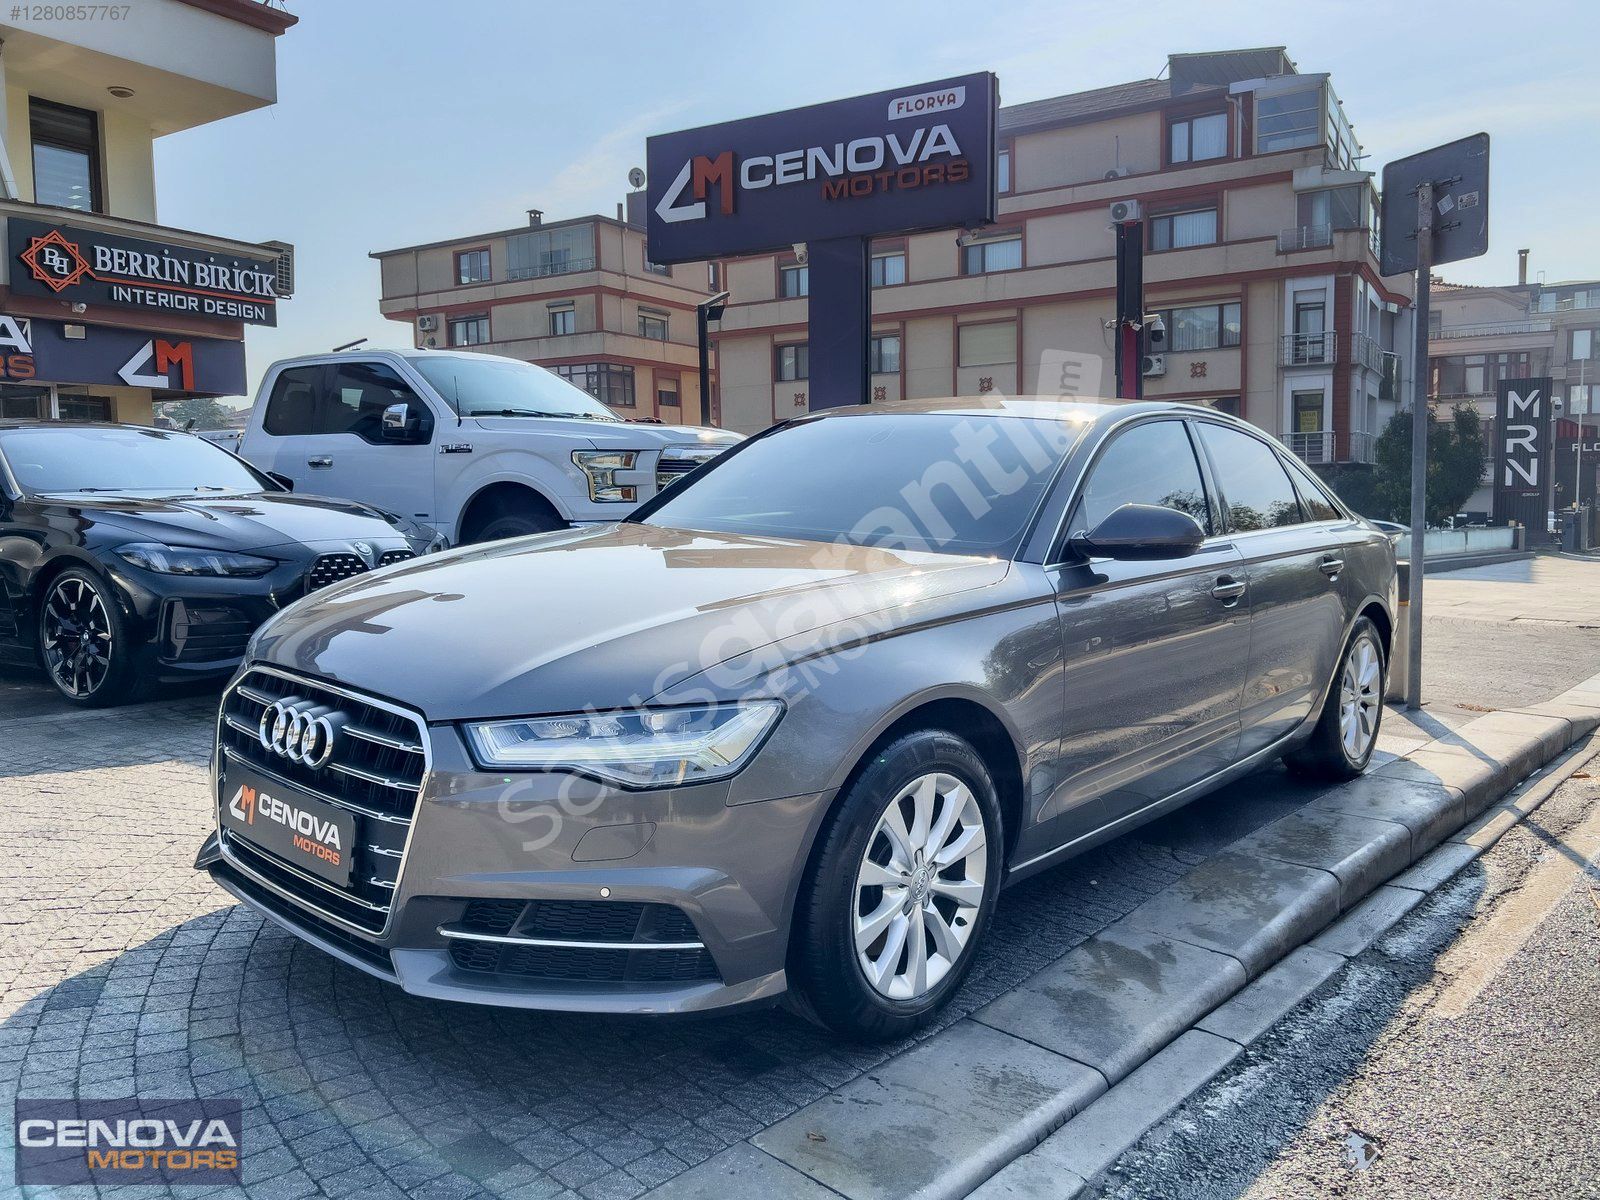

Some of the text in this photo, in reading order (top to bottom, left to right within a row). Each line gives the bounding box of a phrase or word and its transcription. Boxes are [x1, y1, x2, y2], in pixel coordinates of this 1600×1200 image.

[896, 91, 957, 114] FLORYA
[740, 124, 962, 190] CENOVA
[821, 159, 969, 201] MOTORS
[113, 286, 266, 320] INTERIOR DESIGN
[1504, 389, 1540, 487] MRN
[258, 792, 341, 850] CENOVA
[293, 834, 341, 866] MOTORS
